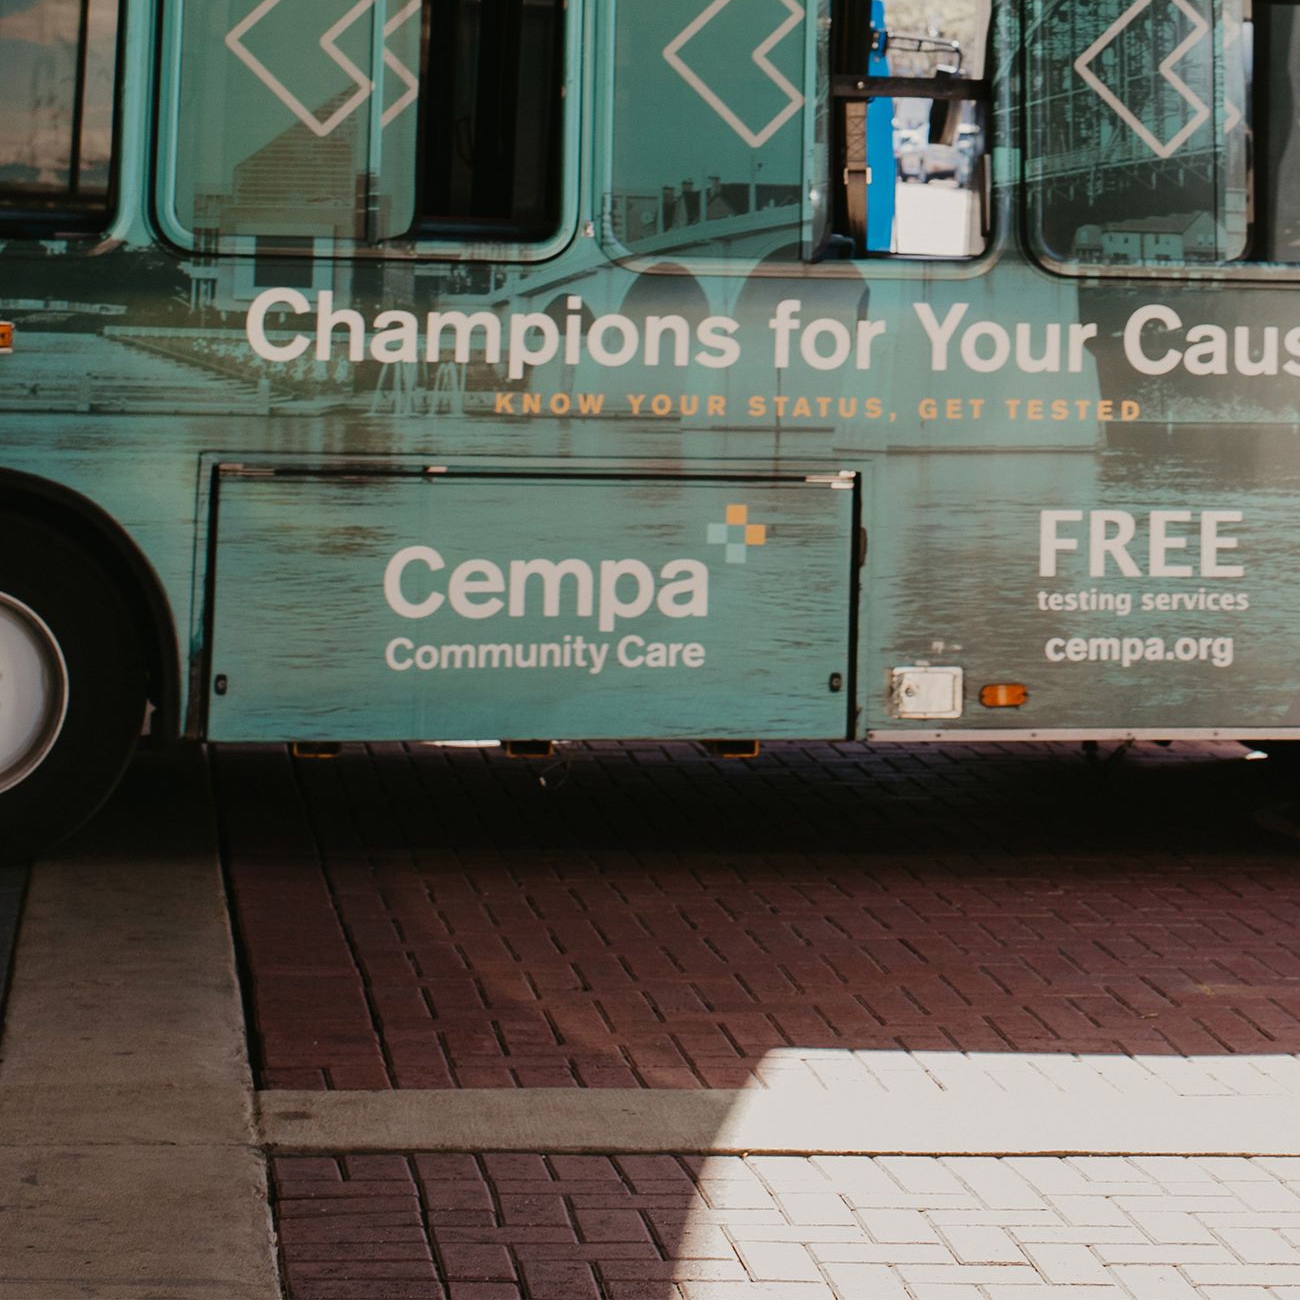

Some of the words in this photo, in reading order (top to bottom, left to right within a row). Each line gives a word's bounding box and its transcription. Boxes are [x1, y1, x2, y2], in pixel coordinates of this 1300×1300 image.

[246, 286, 741, 380] Champions
[769, 299, 886, 371] for
[913, 302, 1098, 374] Your
[495, 391, 606, 416] KNOW
[628, 392, 728, 417] YOUR
[748, 395, 898, 422] STATUS,
[918, 398, 986, 421] GET
[1007, 399, 1142, 422] TESTED
[1039, 509, 1245, 578] FREE
[382, 545, 710, 632] Cempa
[1038, 586, 1132, 616] testing
[1141, 588, 1250, 612] services
[385, 635, 609, 674] Community
[617, 635, 706, 668] Care
[1045, 632, 1234, 667] cempa.org
